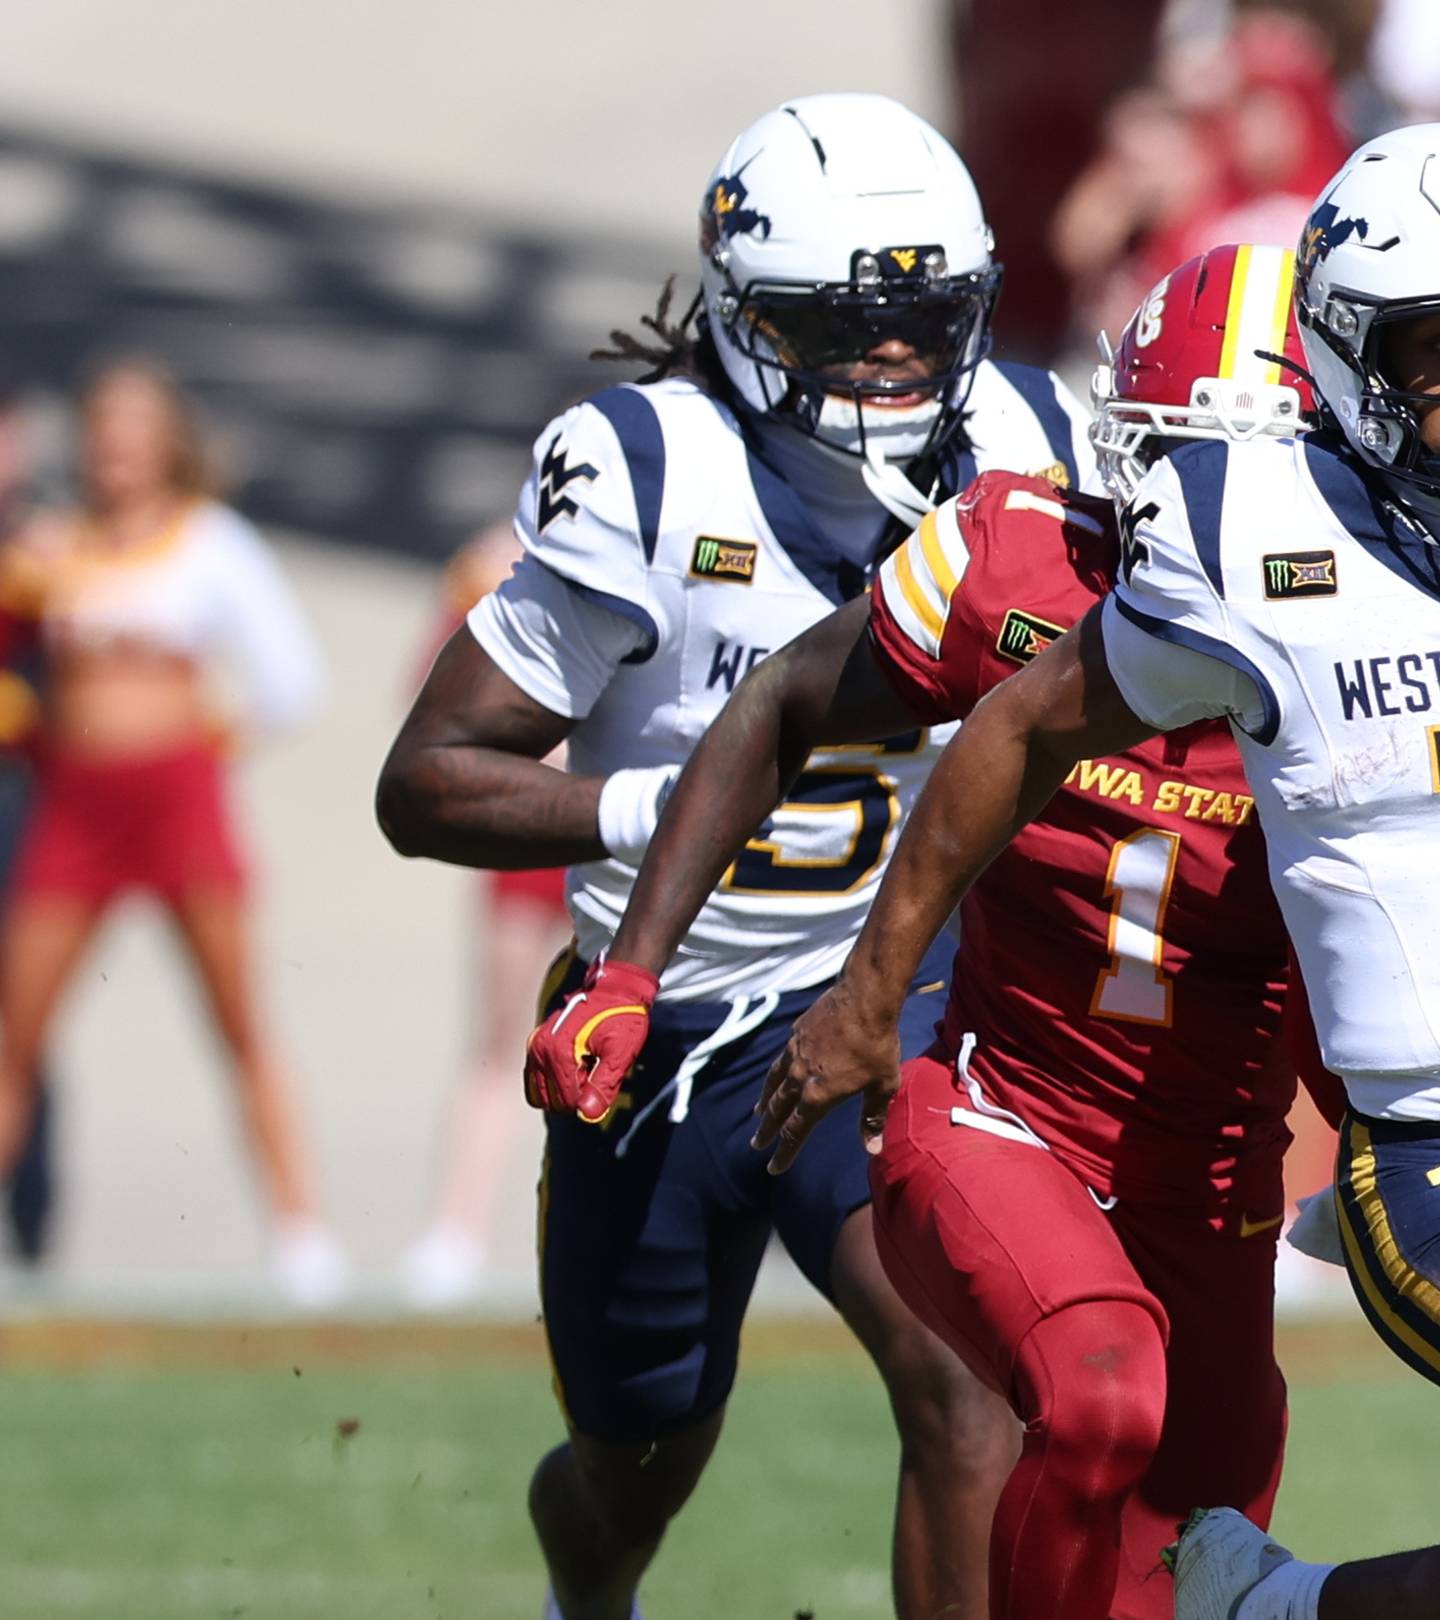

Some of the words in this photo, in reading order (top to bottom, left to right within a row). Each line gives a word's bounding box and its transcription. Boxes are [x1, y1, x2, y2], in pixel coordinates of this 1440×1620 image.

[1064, 759, 1144, 805] WA
[1152, 780, 1255, 826] STAT
[1088, 826, 1182, 1028] 1
